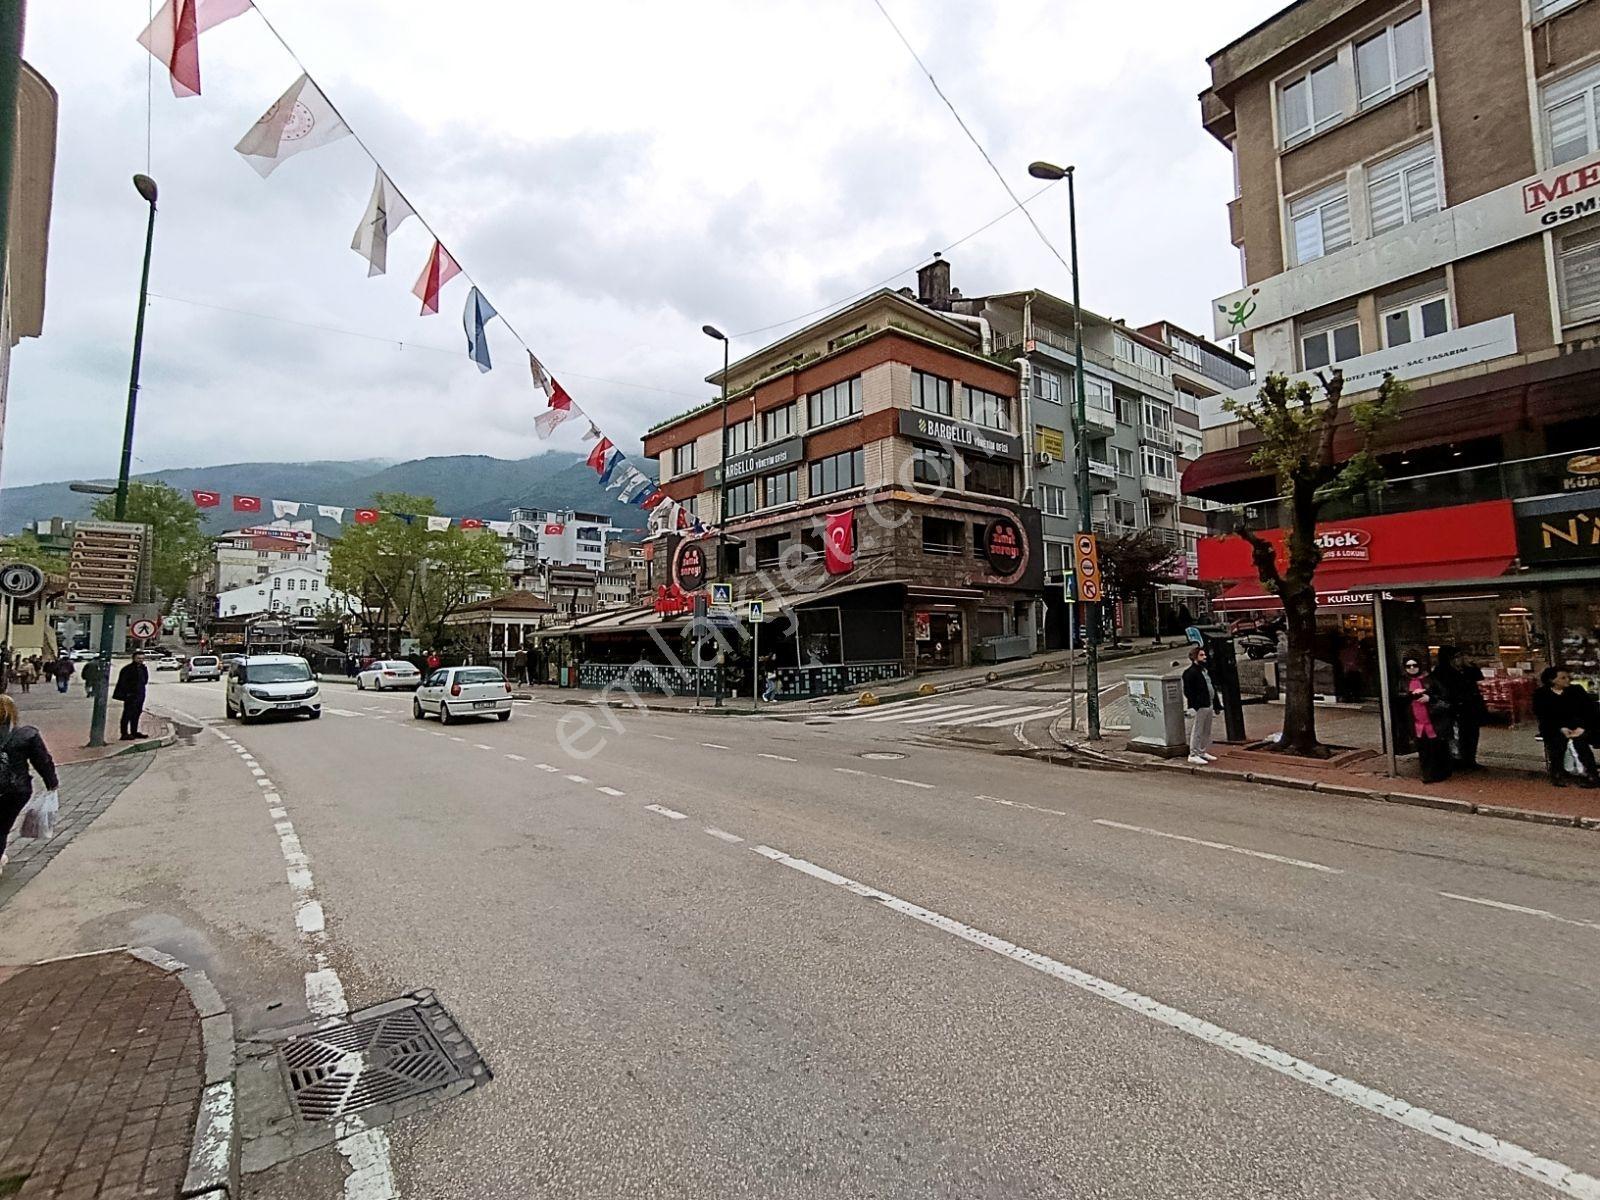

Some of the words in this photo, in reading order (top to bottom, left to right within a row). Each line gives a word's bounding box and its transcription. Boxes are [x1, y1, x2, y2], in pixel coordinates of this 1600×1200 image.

[928, 420, 972, 445] BARGELLO
[725, 458, 754, 479] ARGELLO
[1313, 531, 1360, 548] zbek
